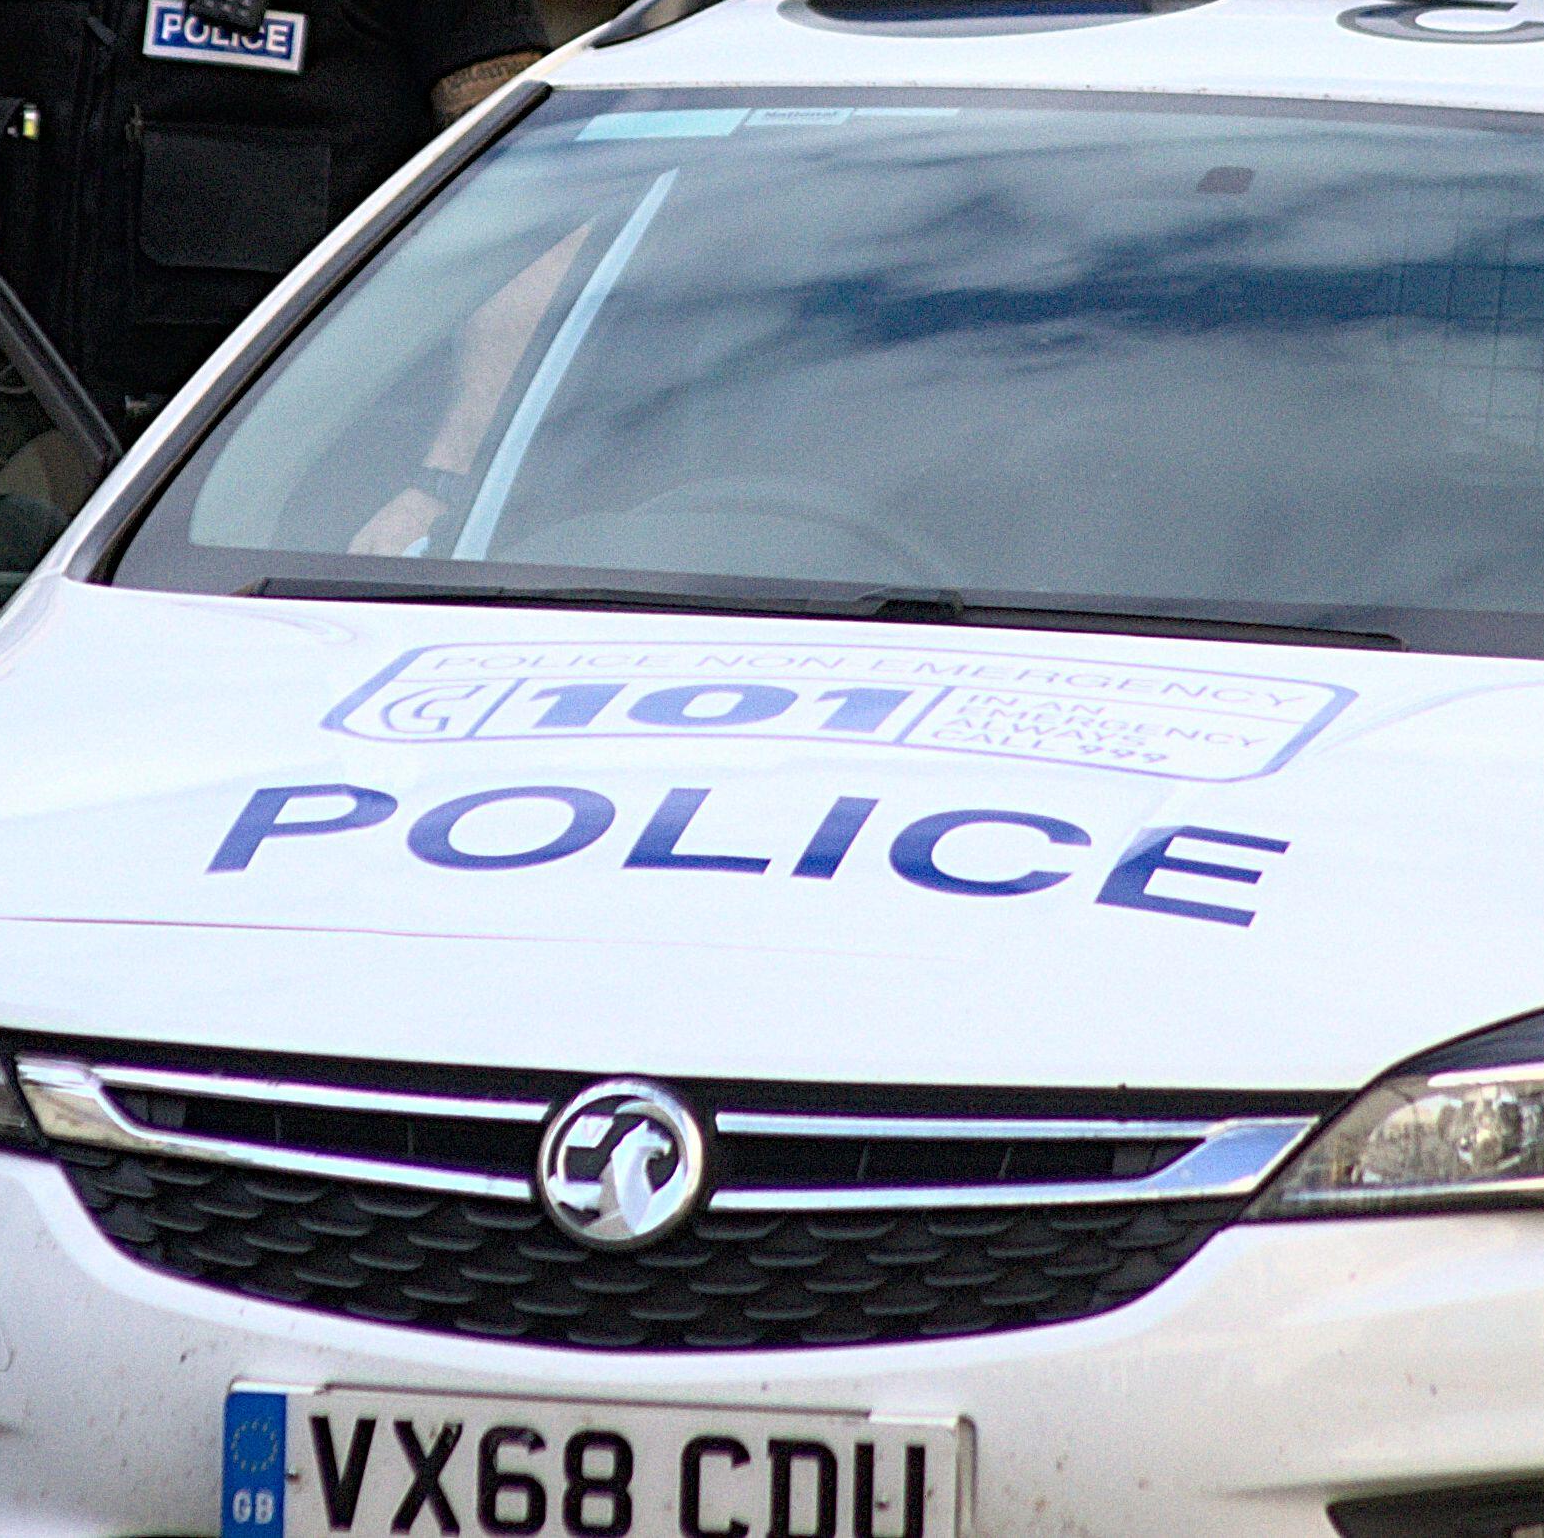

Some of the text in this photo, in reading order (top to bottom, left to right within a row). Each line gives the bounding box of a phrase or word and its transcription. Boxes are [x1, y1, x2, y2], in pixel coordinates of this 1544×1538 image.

[160, 12, 291, 54] POLICE
[434, 654, 1308, 708] POLICE NON EMERGENCY
[528, 681, 916, 735] 101
[965, 693, 1108, 716] IN AN
[930, 729, 1169, 764] CALL 999
[942, 717, 1146, 747] ALWAYS
[956, 705, 1269, 748] EMERGENCY
[203, 782, 1292, 929] POLICE
[308, 1414, 928, 1538] VX68 CDU
[231, 1487, 275, 1524] GB
